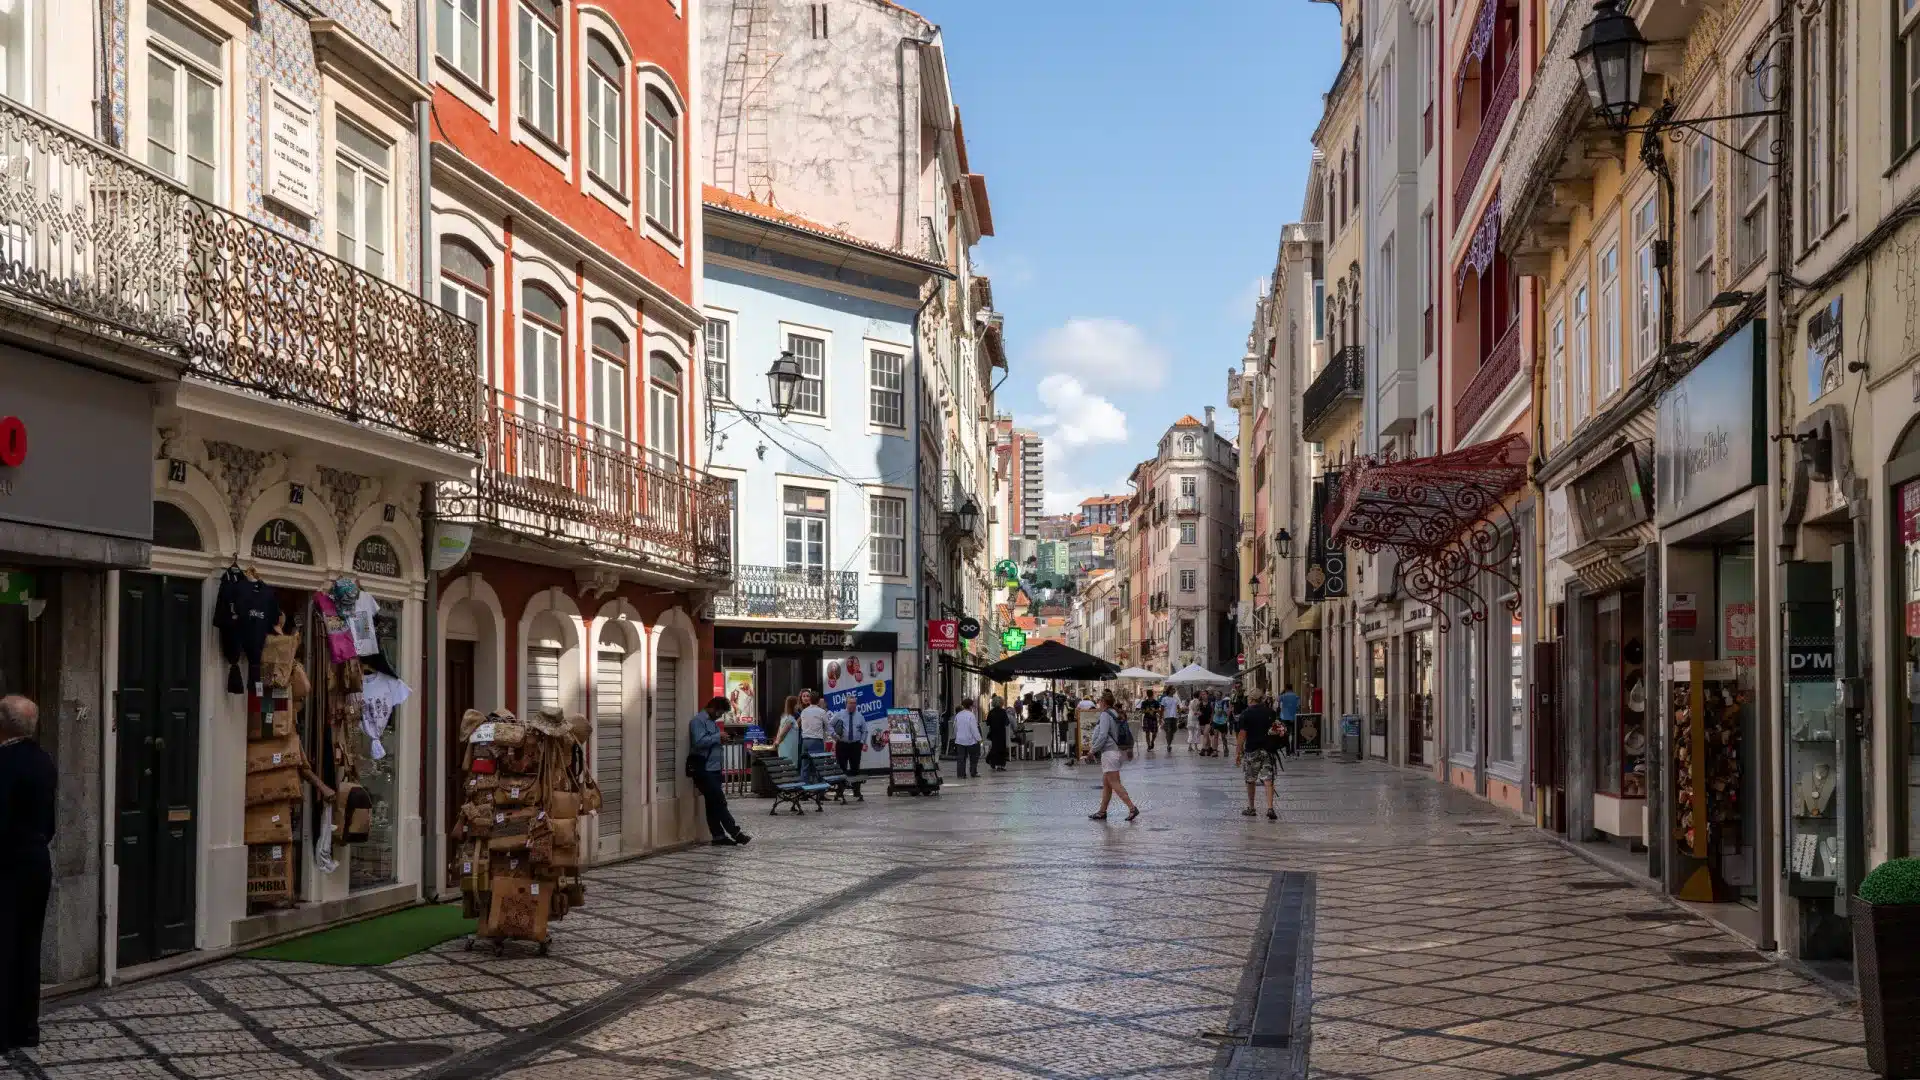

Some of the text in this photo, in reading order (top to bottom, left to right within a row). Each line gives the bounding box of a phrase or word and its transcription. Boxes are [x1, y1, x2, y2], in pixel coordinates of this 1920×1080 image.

[256, 544, 306, 563] HANDICRAFT
[366, 542, 387, 556] GIFTS
[356, 560, 396, 575] SOUVENIRS
[743, 629, 855, 646] ACÚSTICA MÉDICA
